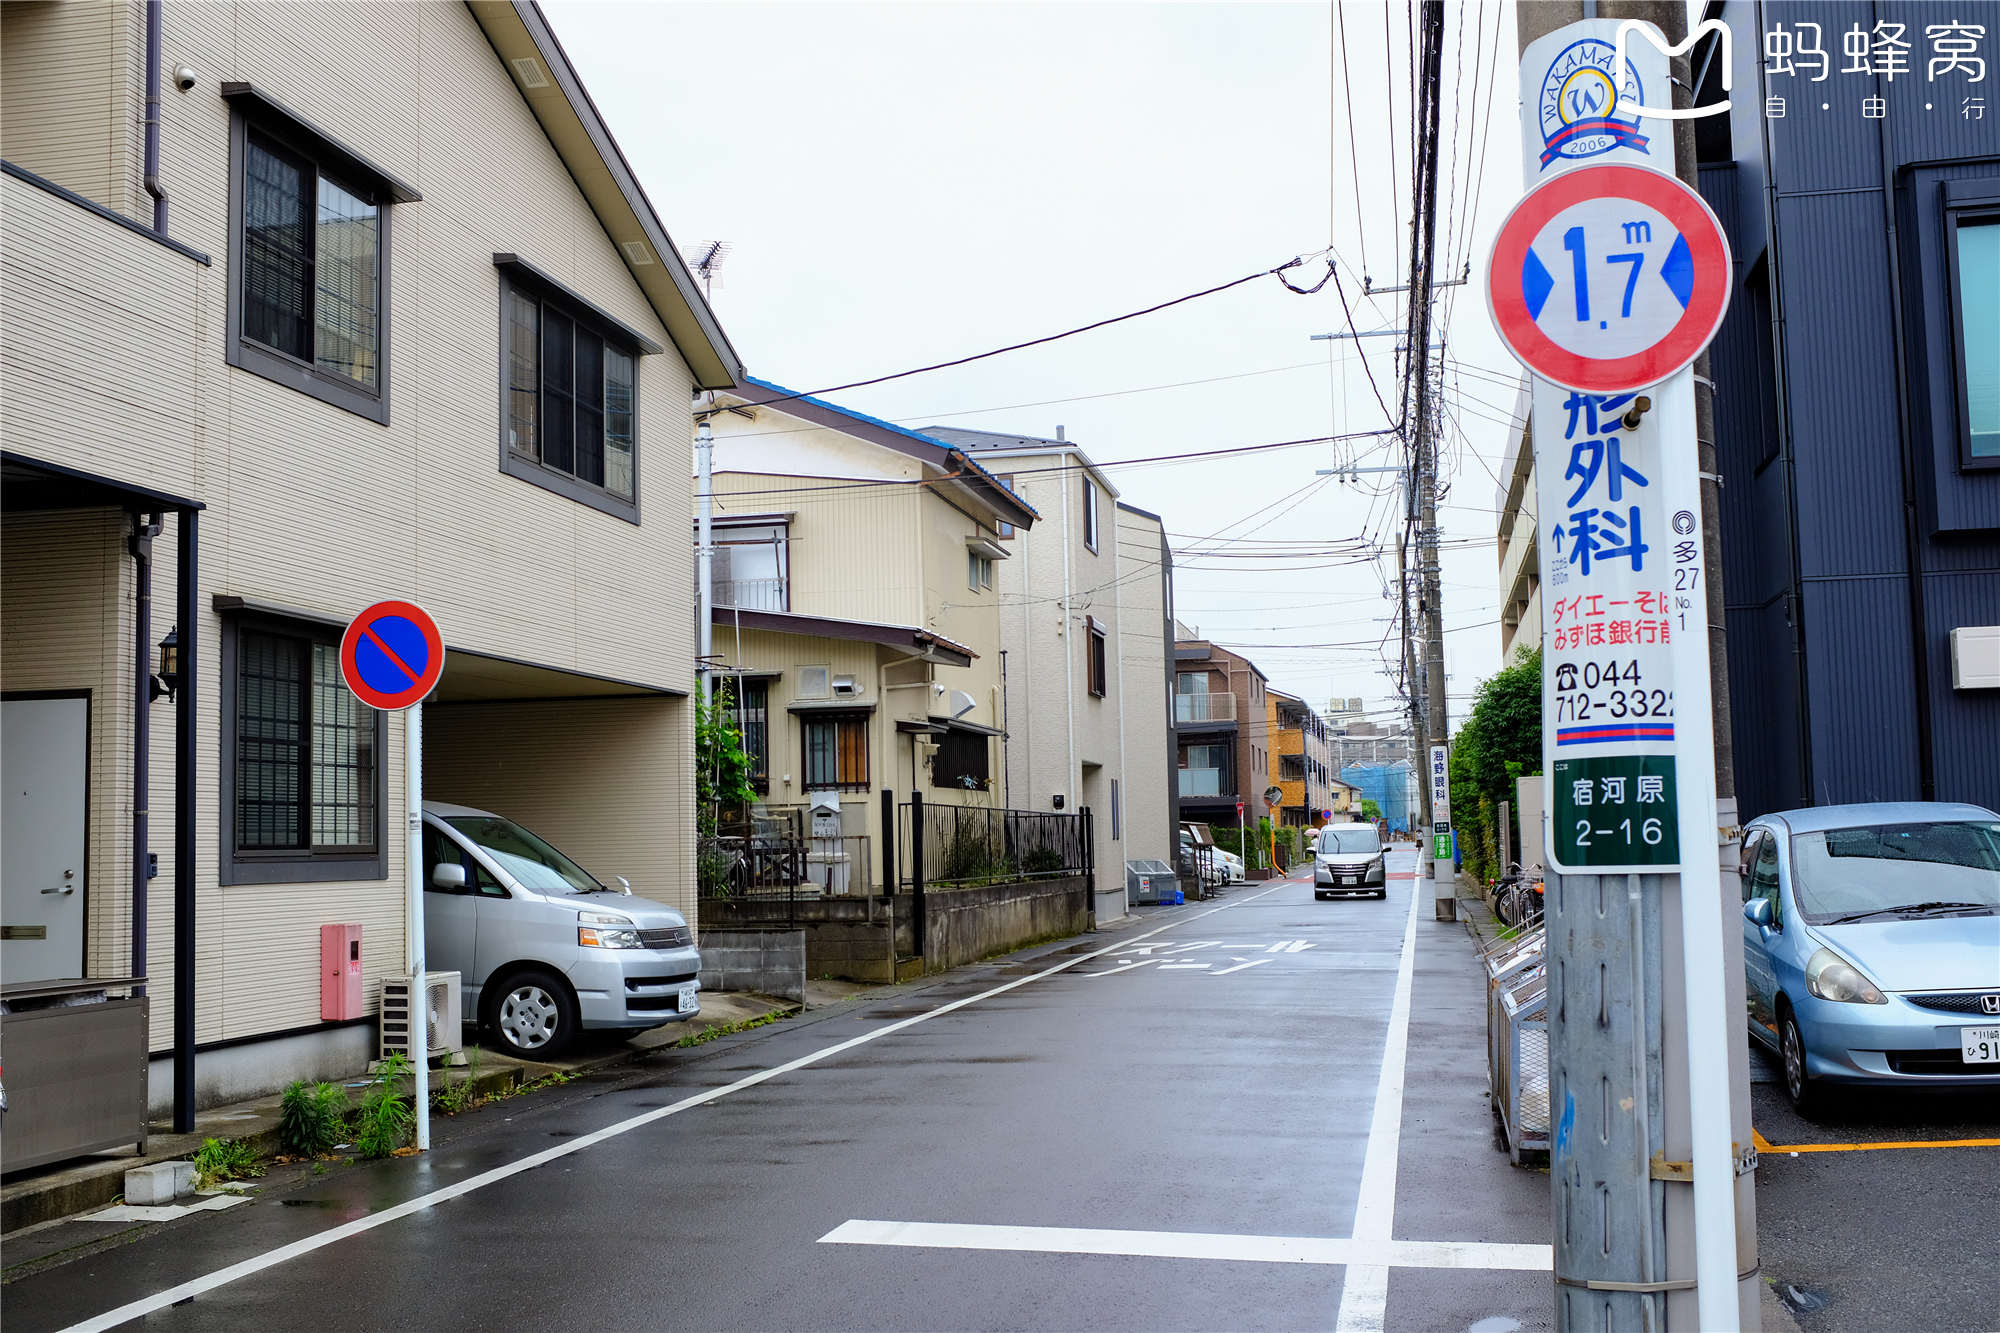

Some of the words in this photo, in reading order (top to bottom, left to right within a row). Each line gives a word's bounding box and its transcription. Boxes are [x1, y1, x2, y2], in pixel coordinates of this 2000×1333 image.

[1570, 137, 1606, 153] 2006
[1673, 541, 1698, 563] 多
[1674, 567, 1699, 591] 27
[1675, 596, 1693, 610] No.
[1677, 612, 1685, 631] 1
[1583, 659, 1642, 690] 044
[1556, 689, 1674, 723] 712-332
[1572, 776, 1665, 806] 宿河原
[1576, 818, 1663, 847] 2-16
[1979, 1030, 1999, 1039] 川崎
[1967, 1046, 1976, 1056] ひ
[1979, 1041, 1999, 1060] 91
